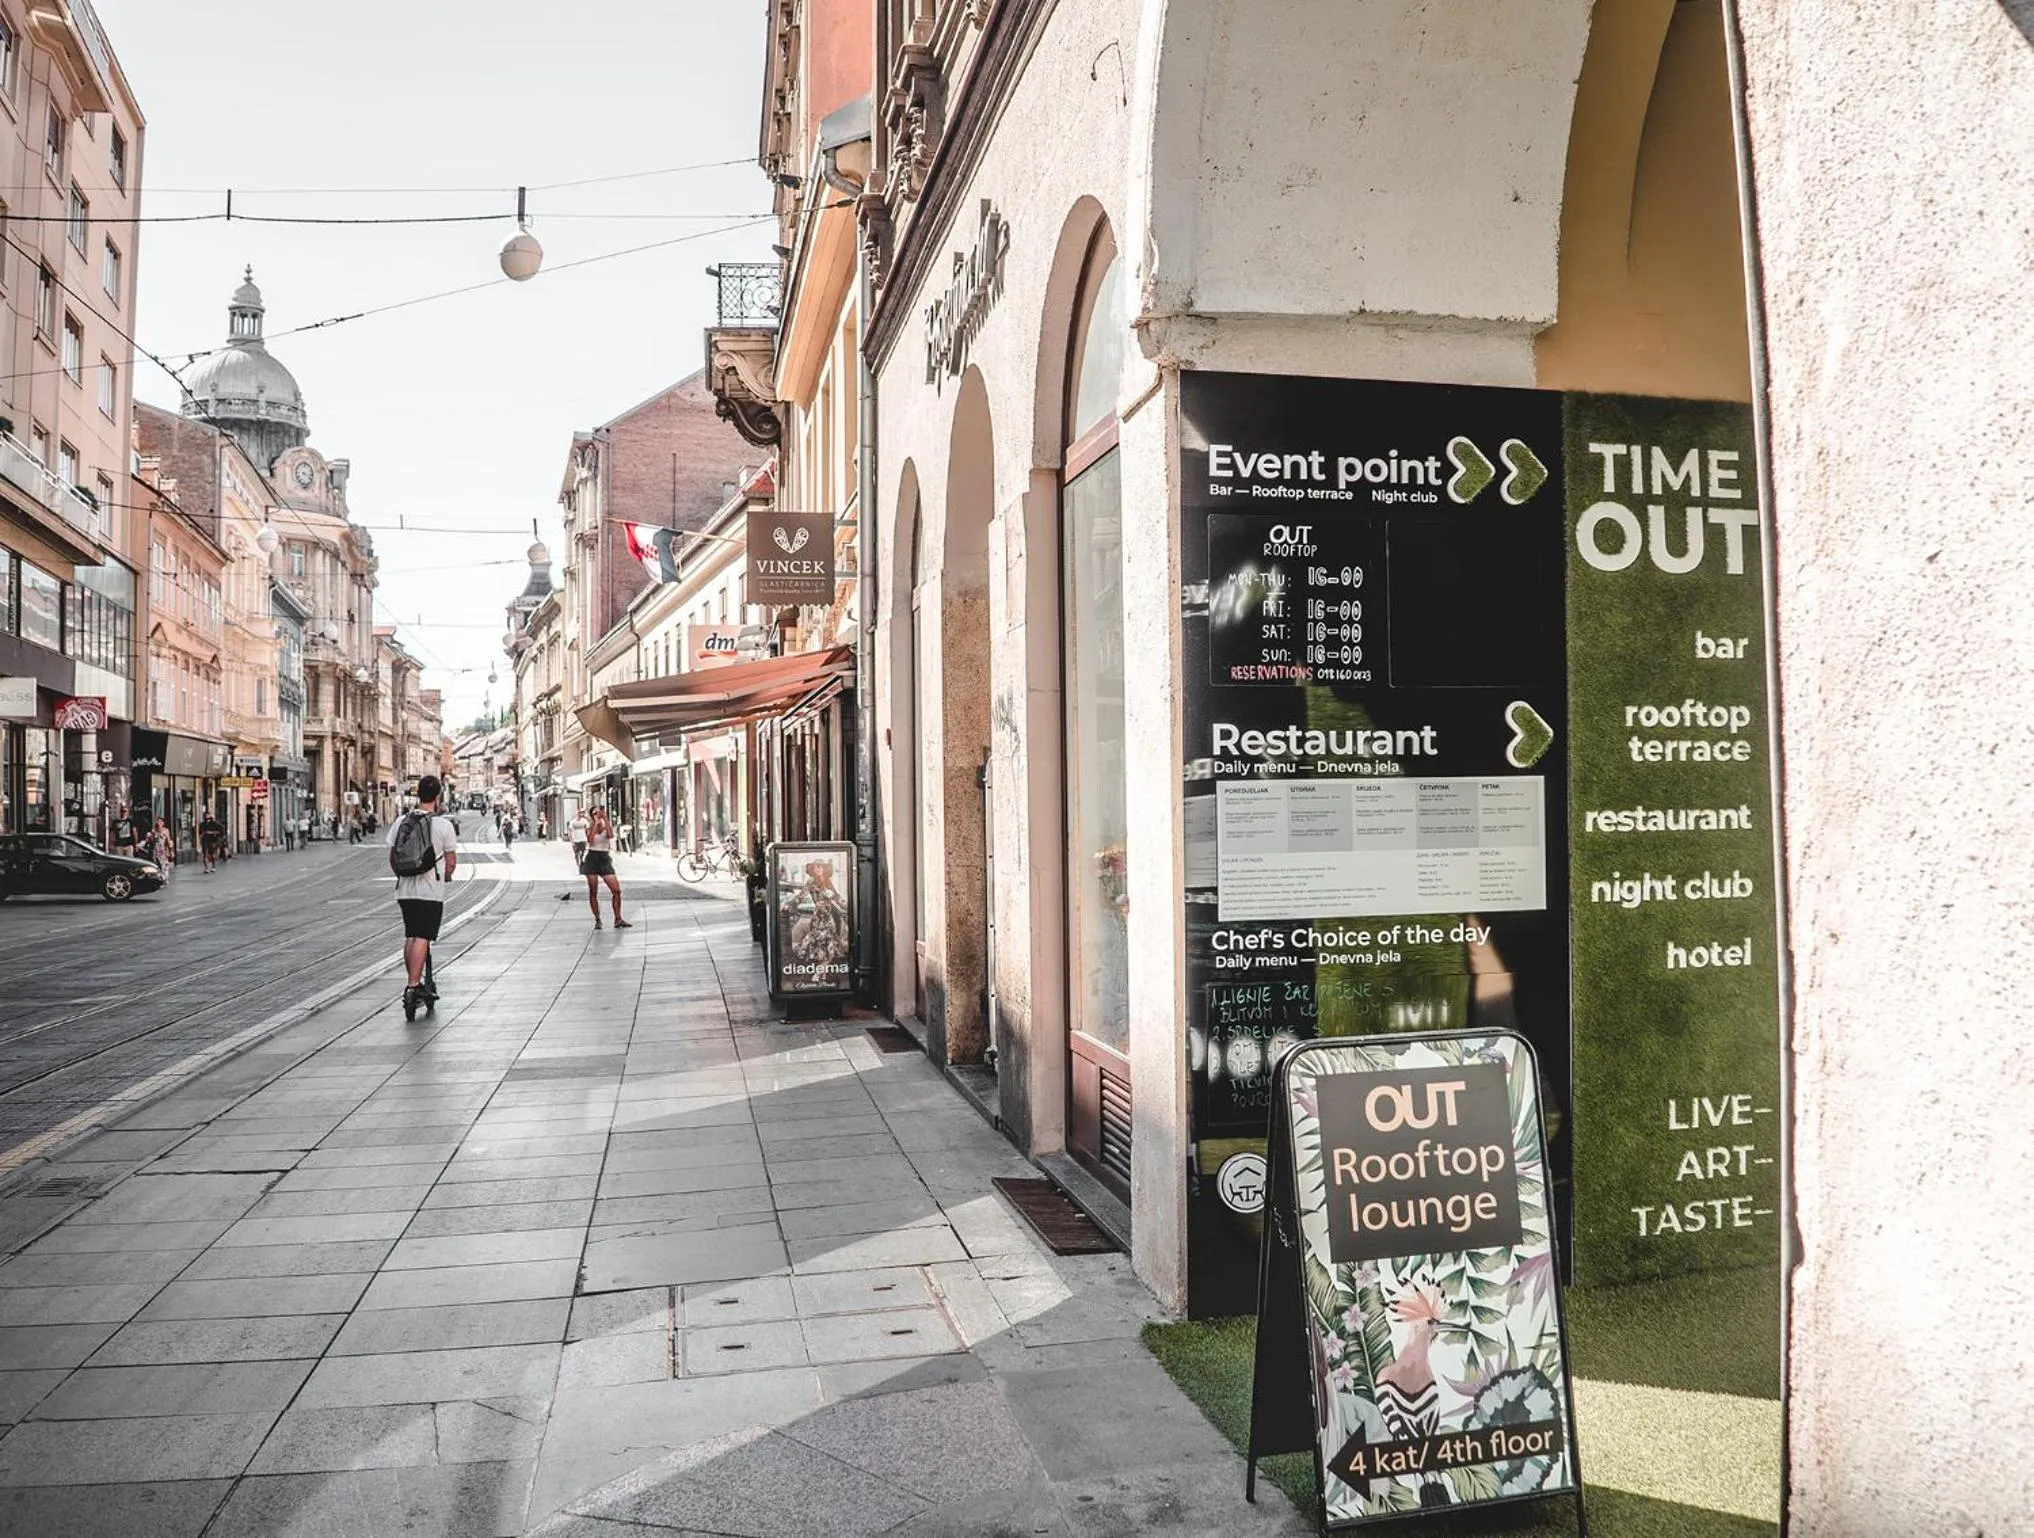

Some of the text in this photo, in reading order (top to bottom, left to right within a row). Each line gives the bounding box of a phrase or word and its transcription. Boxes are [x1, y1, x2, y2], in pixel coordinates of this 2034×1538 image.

[1208, 444, 1442, 490] Event point
[1588, 442, 1742, 498] TIME
[1209, 484, 1233, 496] Bar
[1252, 486, 1305, 500] Rooftop
[1306, 489, 1353, 500] terrace
[1372, 490, 1407, 504] Night
[1410, 491, 1438, 503] club
[1263, 543, 1318, 557] ROOFTOP
[1269, 524, 1312, 544] OUT
[1575, 501, 1759, 575] OUT
[757, 560, 826, 574] VINCEK
[705, 632, 735, 650] dm
[1695, 630, 1749, 660] bar
[1231, 664, 1313, 680] RESERVATIONS
[1625, 699, 1750, 733] rooftop
[1211, 723, 1438, 757] Restaurant
[1628, 735, 1751, 763] terrace
[1214, 761, 1250, 776] Daily
[1254, 763, 1296, 774] menu
[1318, 761, 1371, 774] Dnevna
[1374, 760, 1400, 776] jela
[1585, 804, 1752, 832] restaurant
[1591, 869, 1753, 909] night club
[1211, 922, 1491, 950] Chef's Choice of the day
[783, 963, 849, 975] diadema
[1215, 955, 1253, 970] Daily
[1255, 955, 1297, 967] menu
[1319, 951, 1373, 965] Dnevna
[1374, 950, 1401, 966] jela
[1666, 937, 1752, 969] hotel
[1365, 1080, 1466, 1132] OUT
[1668, 1094, 1774, 1130] LIVE-
[1333, 1140, 1505, 1186] Rooftop
[1676, 1145, 1774, 1182] ART-
[1350, 1191, 1498, 1233] lounge
[1631, 1196, 1774, 1237] TASTE-
[1349, 1428, 1554, 1476] 4 kat/ 4th floor
